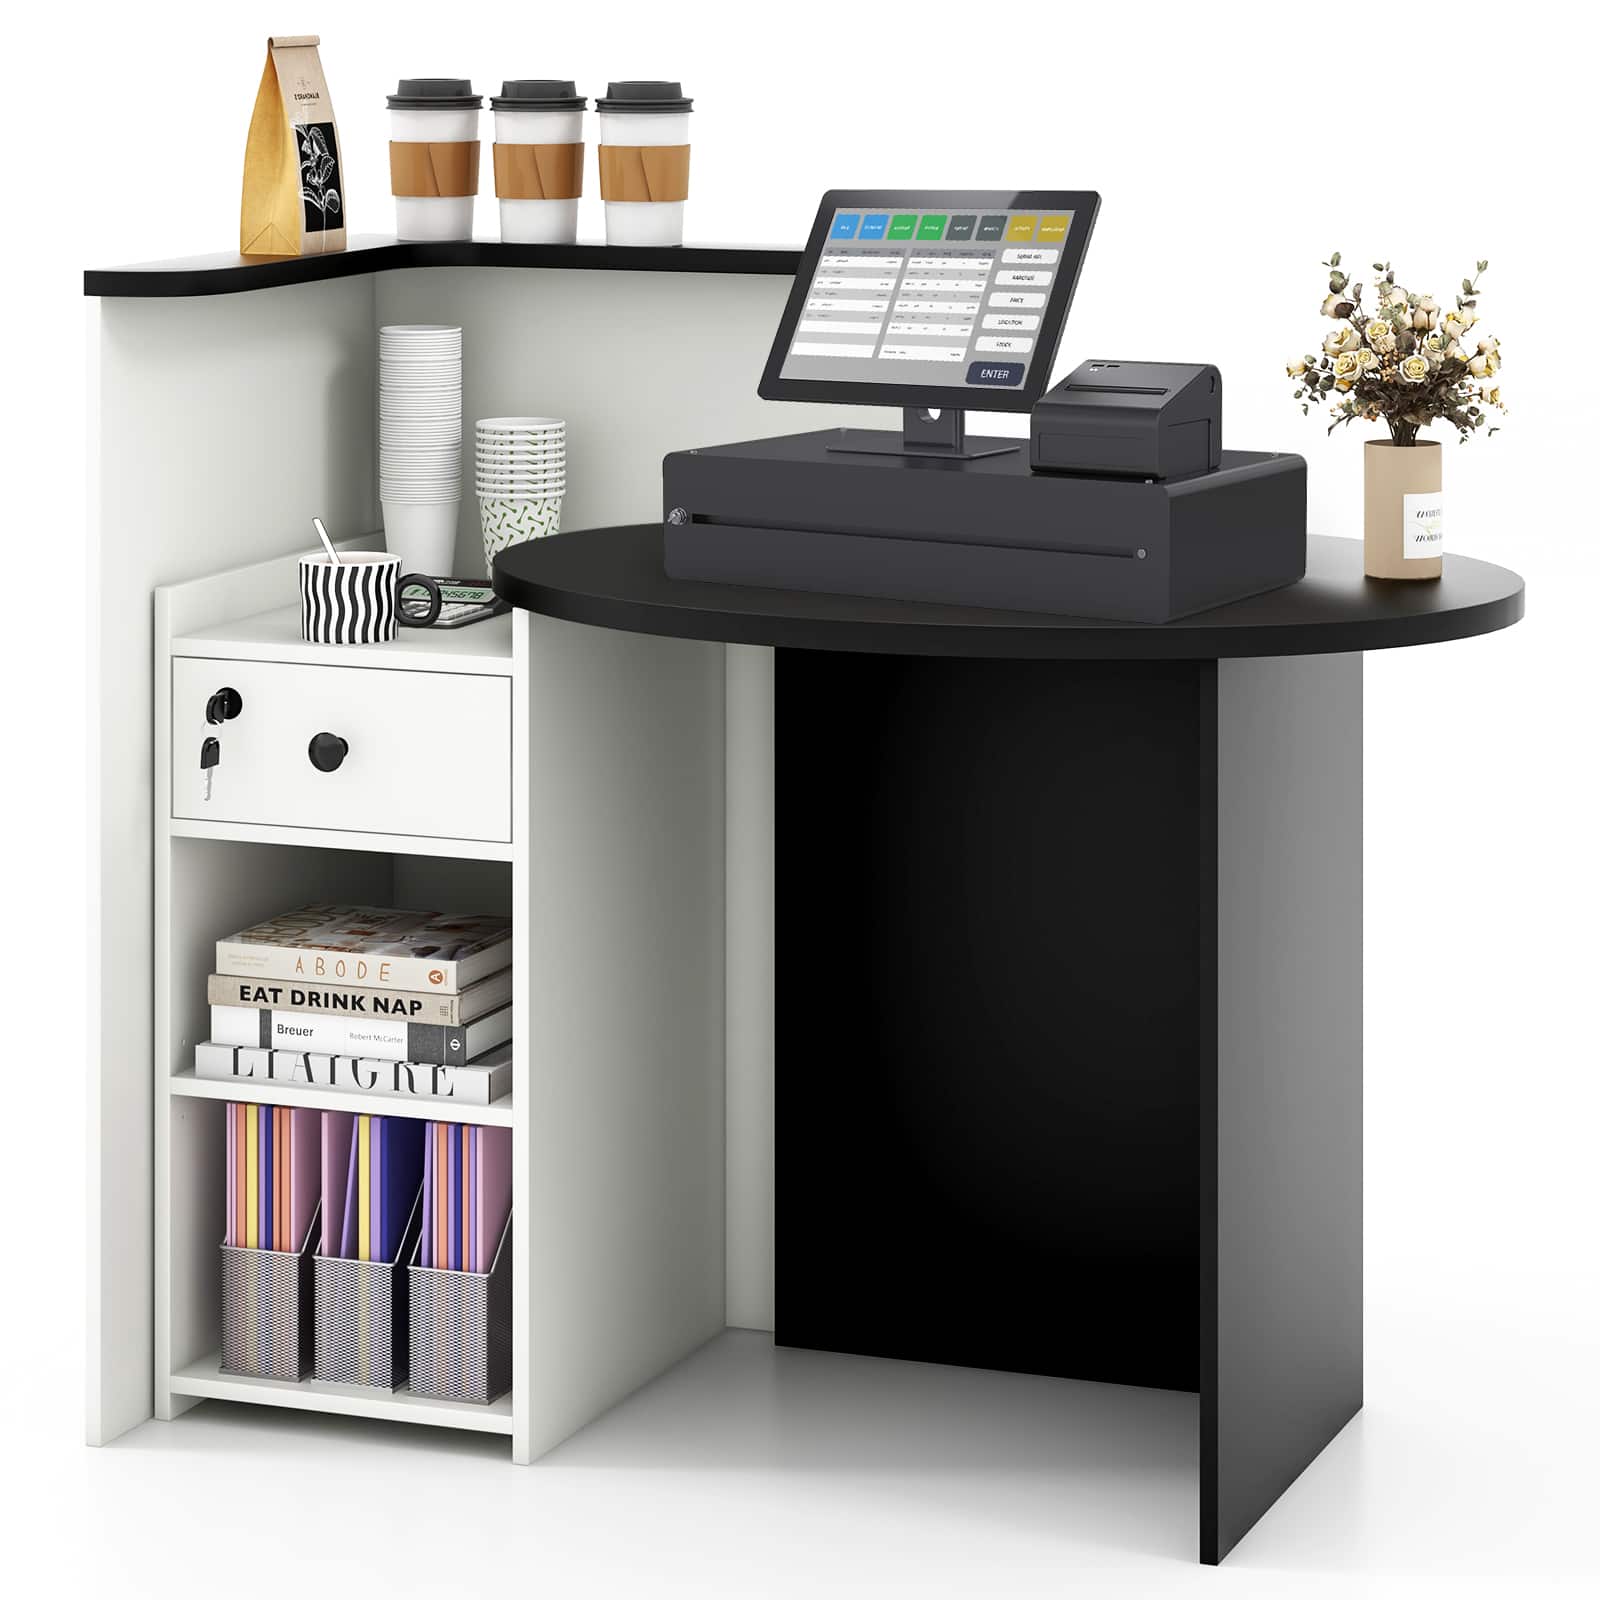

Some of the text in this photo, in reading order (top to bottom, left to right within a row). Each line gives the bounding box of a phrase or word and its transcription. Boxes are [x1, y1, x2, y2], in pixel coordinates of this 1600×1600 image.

[980, 368, 1010, 380] ENTER
[295, 954, 392, 983] ABODE
[239, 984, 283, 1004] EAT
[290, 989, 366, 1012] DRINK
[373, 996, 423, 1017] NAP
[276, 1023, 315, 1037] Breuer
[349, 1032, 404, 1045] Robert McCarter
